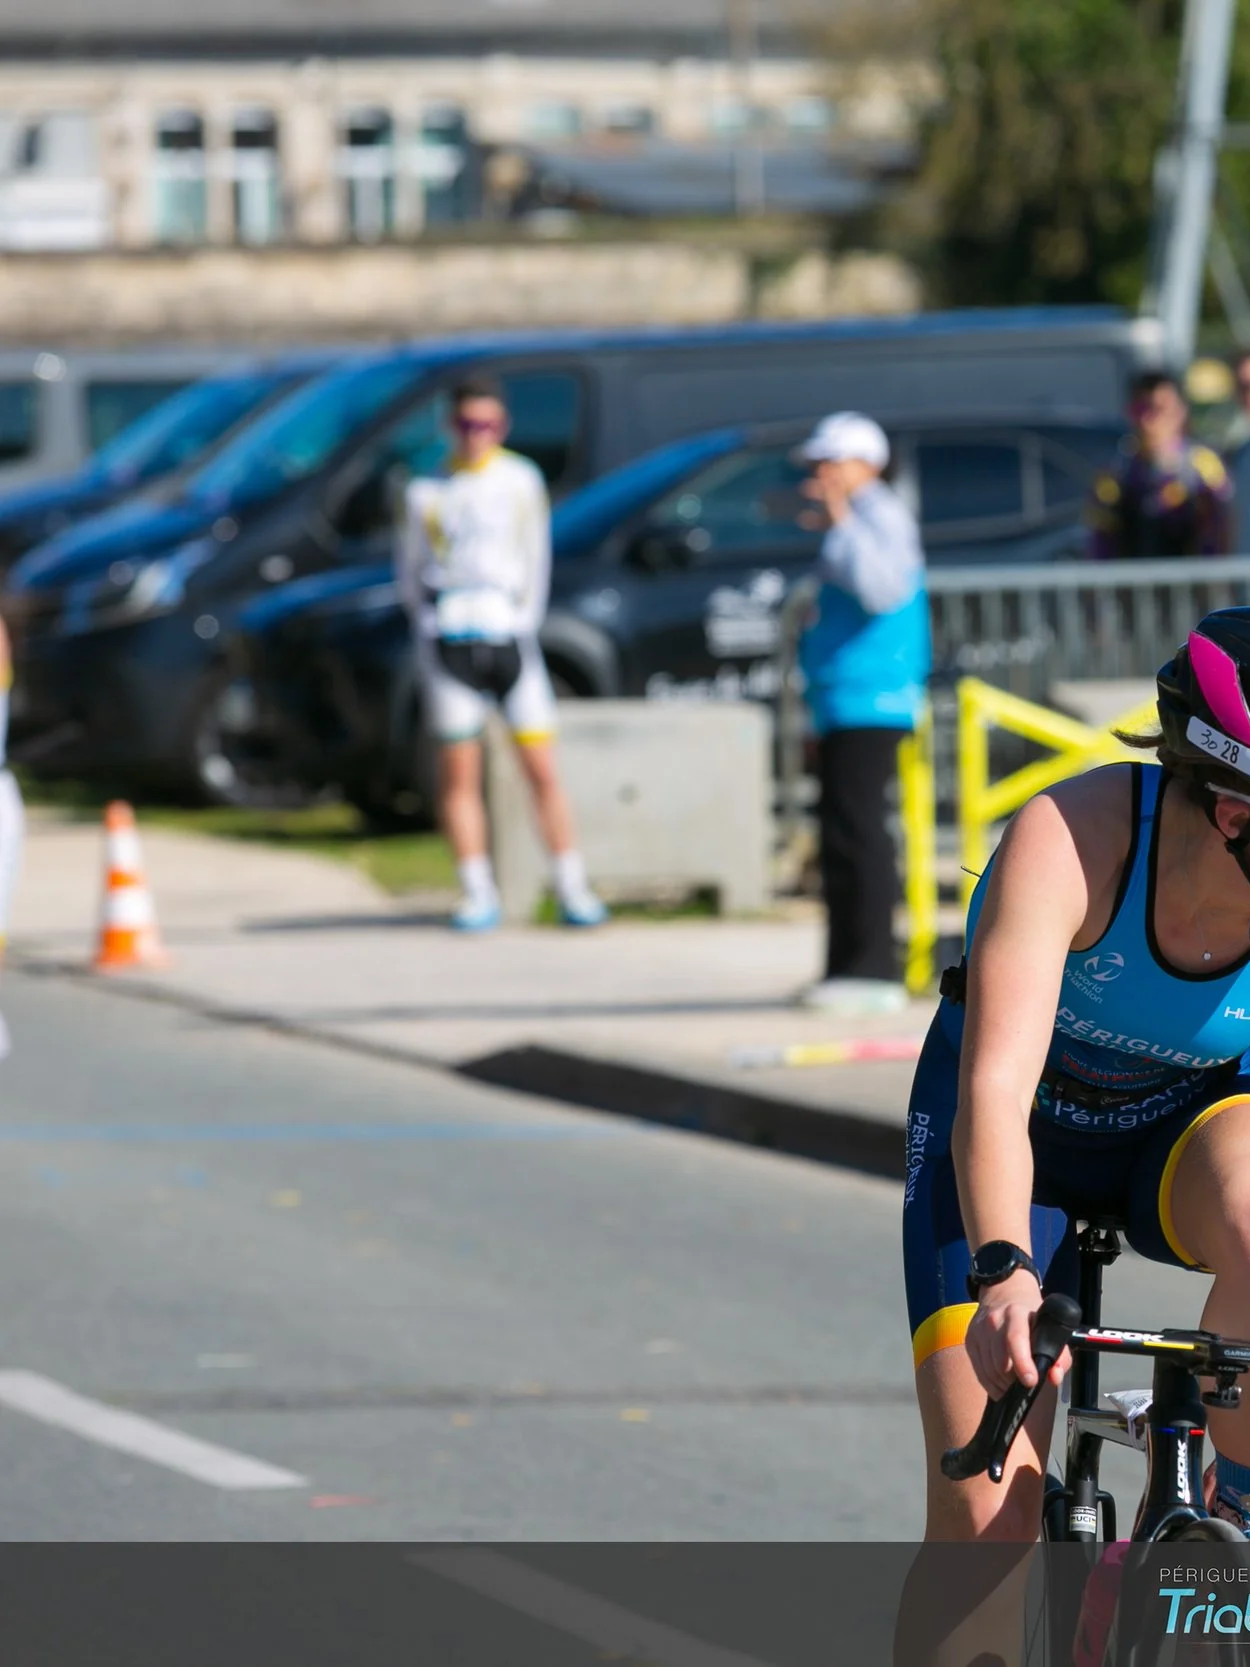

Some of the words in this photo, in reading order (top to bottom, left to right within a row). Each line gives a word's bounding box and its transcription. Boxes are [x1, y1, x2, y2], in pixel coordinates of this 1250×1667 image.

[1220, 740, 1240, 764] 28
[1073, 969, 1104, 993] World
[1088, 1328, 1165, 1342] LOOK
[1177, 1439, 1190, 1504] LOOK
